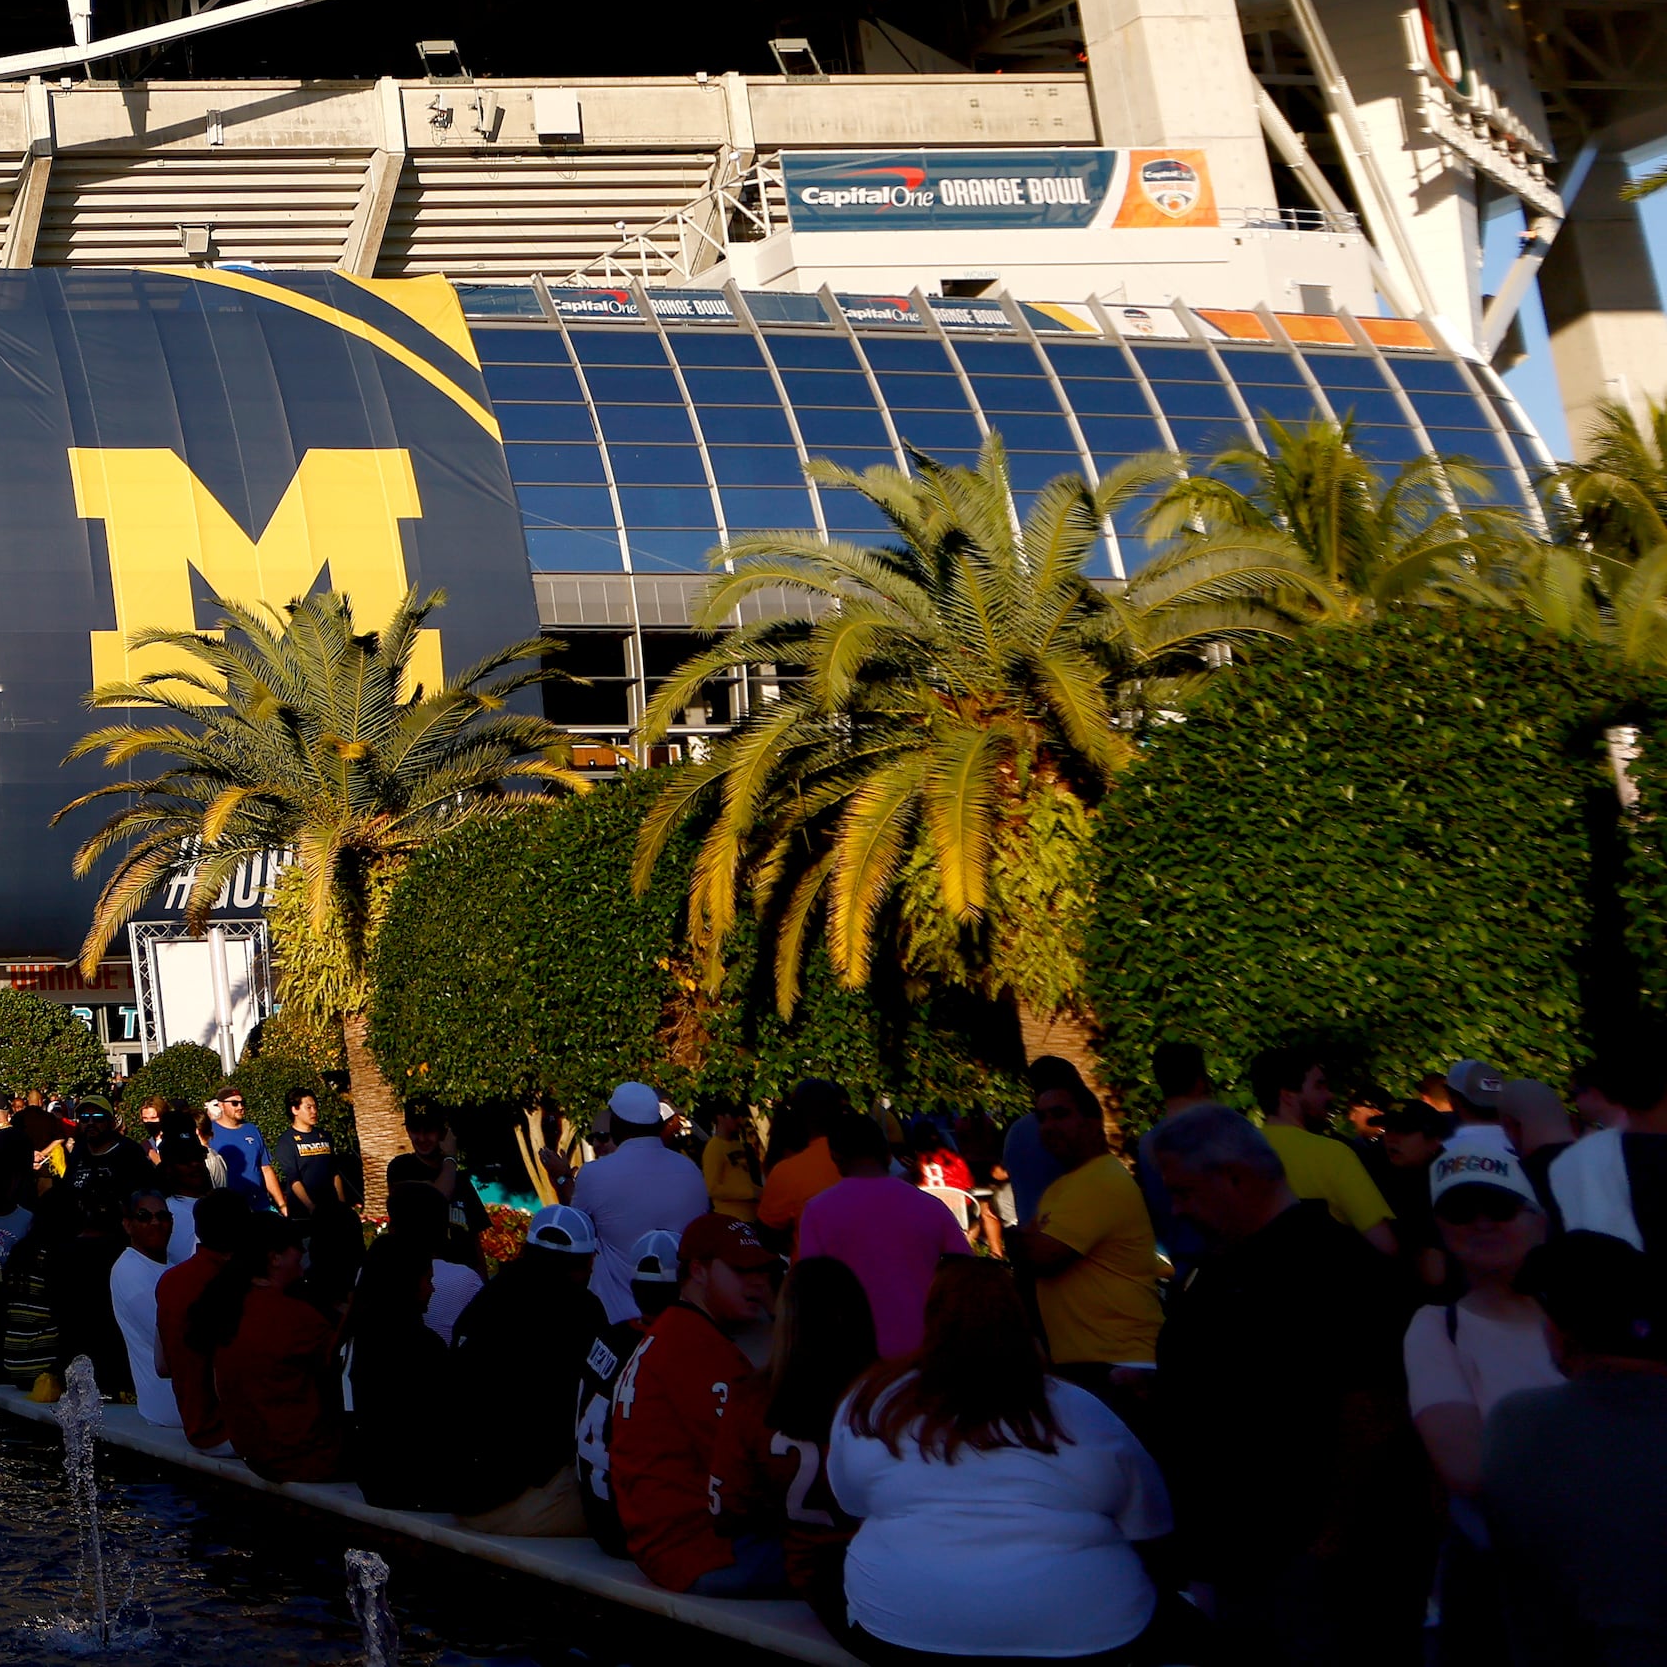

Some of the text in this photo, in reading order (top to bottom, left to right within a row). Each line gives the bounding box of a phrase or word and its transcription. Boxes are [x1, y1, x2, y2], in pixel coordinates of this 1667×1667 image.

[939, 178, 1026, 207] ORANGE
[1028, 177, 1090, 206] BOWL
[651, 299, 696, 315] RANGE
[696, 300, 733, 317] BOWL
[932, 308, 974, 324] RANGE
[974, 309, 1011, 326] BOWL
[1436, 1154, 1508, 1182] OREGON
